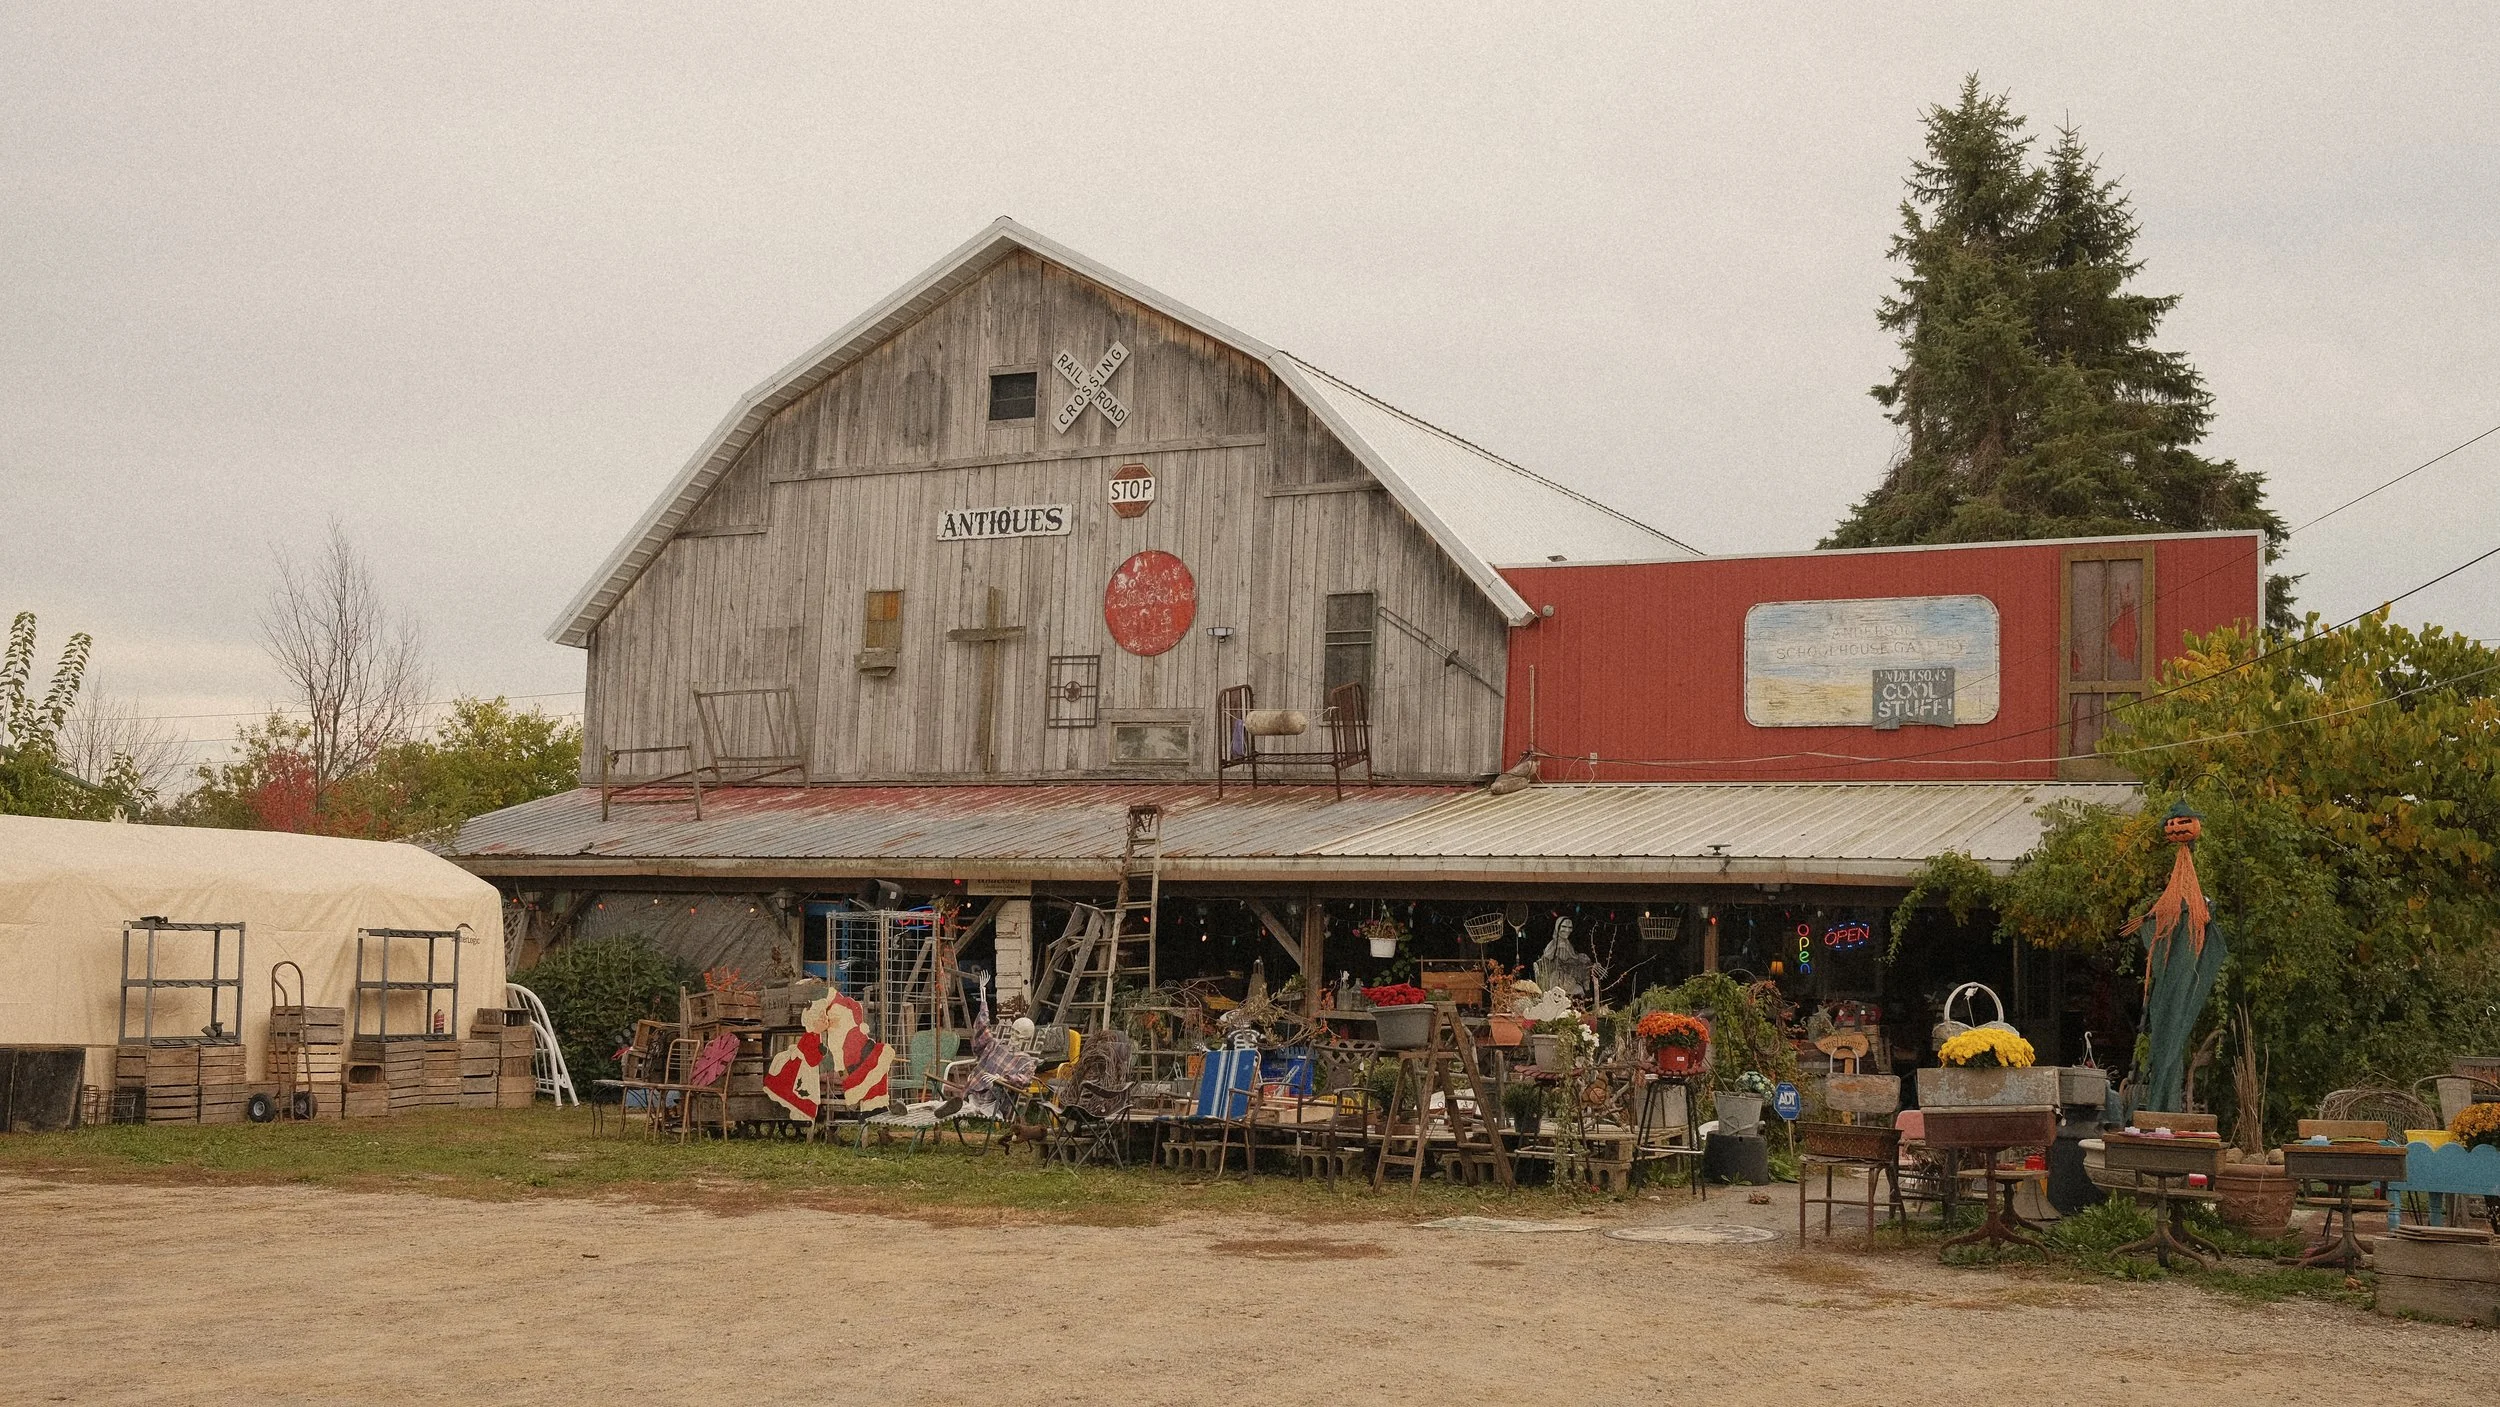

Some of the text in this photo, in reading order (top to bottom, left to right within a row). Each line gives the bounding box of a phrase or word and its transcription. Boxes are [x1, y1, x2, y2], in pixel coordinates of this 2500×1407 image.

[1057, 353, 1126, 422] RAIL ROAD
[1058, 348, 1122, 425] CROSSING
[1111, 479, 1152, 500] STOP
[941, 507, 1063, 538] ANTIQUES
[1882, 681, 1939, 700] COOL
[1878, 697, 1953, 718] STUFF!
[1824, 925, 1870, 946] OPEN
[1778, 1091, 1797, 1105] ADT
